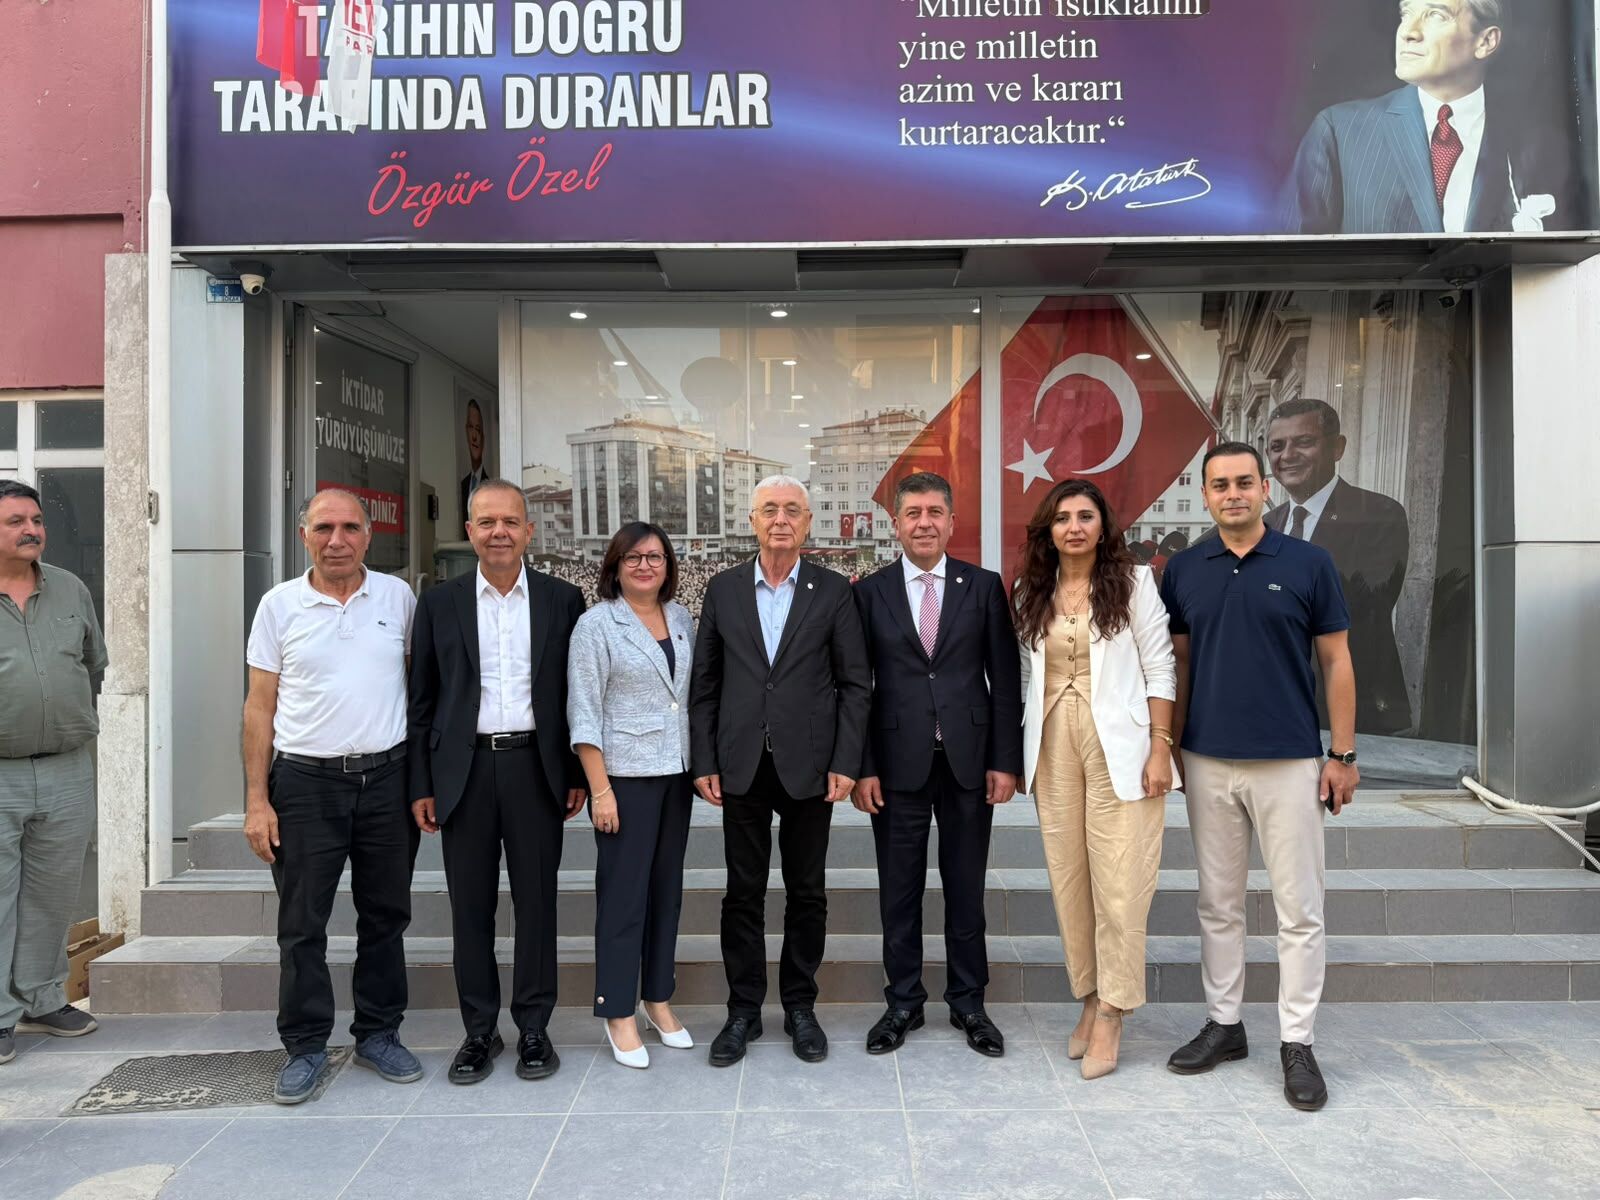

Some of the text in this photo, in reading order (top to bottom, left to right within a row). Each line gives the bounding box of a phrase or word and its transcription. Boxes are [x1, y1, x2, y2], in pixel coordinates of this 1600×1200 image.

[899, 30, 1099, 68] yine milletin
[505, 73, 769, 130] DURANLAR
[899, 73, 1124, 103] azim ve kararı
[368, 136, 613, 228] Özgür Özel
[341, 369, 385, 416] İKTİDAR
[316, 412, 405, 464] YÜRÜYÜŞÜMÜZE
